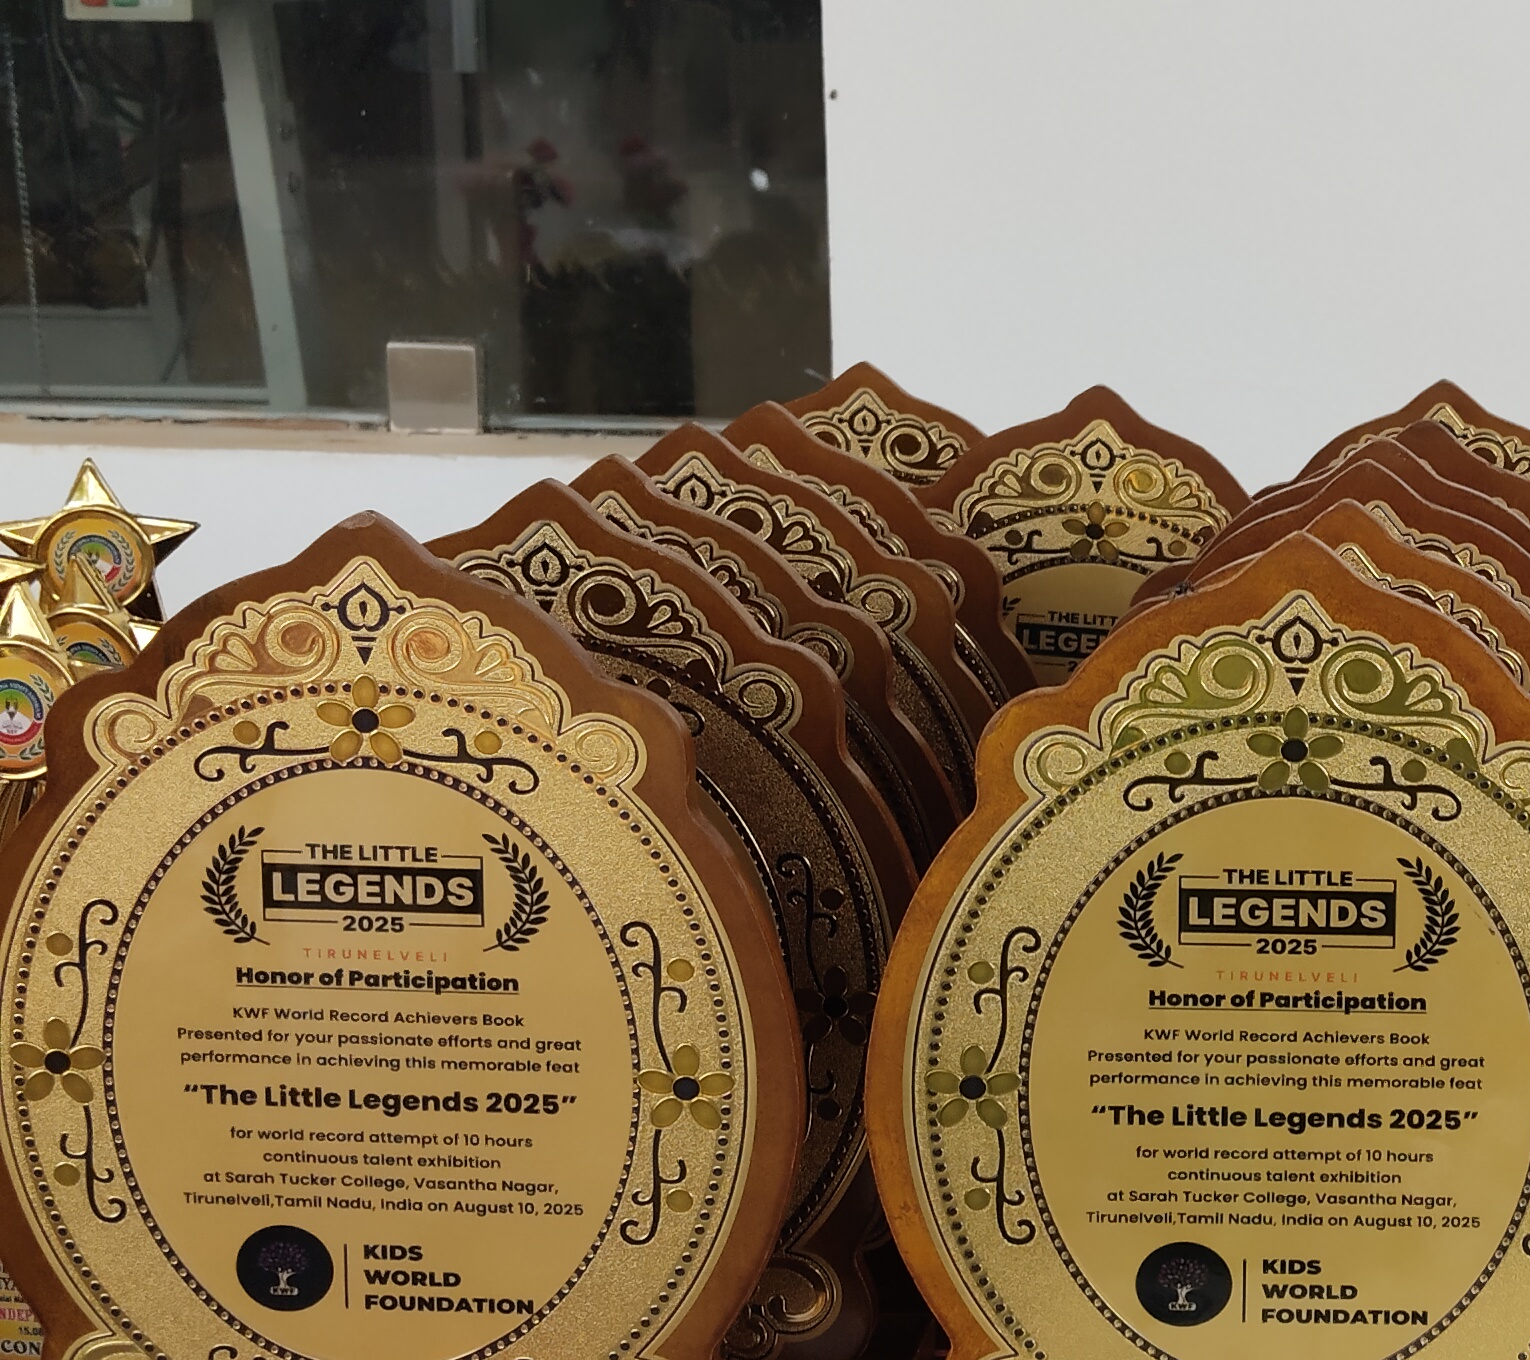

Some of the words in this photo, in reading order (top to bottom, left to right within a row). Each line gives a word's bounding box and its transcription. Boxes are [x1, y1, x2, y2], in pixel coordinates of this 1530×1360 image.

[303, 841, 353, 861] THE
[357, 843, 438, 863] LITTLE
[1221, 867, 1270, 886] THE
[1273, 868, 1353, 887] LITTLE
[271, 870, 474, 907] LEGENDS
[1187, 895, 1387, 929] LEGENDS
[341, 914, 405, 934] 2025
[1255, 936, 1318, 956] 2025
[235, 966, 314, 987] Honor
[318, 968, 345, 987] of
[348, 969, 520, 996] Participation
[1214, 969, 1358, 984] TIRUNELVELI
[1148, 988, 1227, 1008] Honor
[1230, 990, 1257, 1009] of
[1259, 990, 1428, 1015] Participation
[1142, 1027, 1181, 1041] KWF
[1183, 1028, 1235, 1042] World
[1238, 1029, 1298, 1043] Record
[1301, 1029, 1385, 1045] Achievers
[1388, 1031, 1430, 1046] Book
[1086, 1048, 1173, 1063] Presented
[1175, 1048, 1200, 1064] for
[1202, 1052, 1243, 1068] your
[1245, 1050, 1341, 1068] passionate
[1343, 1051, 1398, 1067] efforts
[1401, 1053, 1436, 1068] and
[1438, 1055, 1485, 1072] great
[1088, 1070, 1201, 1088] performance
[1203, 1071, 1220, 1086] in
[1223, 1072, 1308, 1091] achieving
[1310, 1073, 1342, 1088] this
[1346, 1075, 1446, 1089] memorable
[1448, 1075, 1483, 1090] feat
[182, 1082, 258, 1106] “The
[263, 1082, 342, 1109] Little
[347, 1087, 479, 1116] Legends
[484, 1091, 577, 1115] 2025”
[1090, 1103, 1165, 1126] “The
[1171, 1102, 1248, 1127] Little
[1253, 1106, 1383, 1134] Legends
[1388, 1107, 1479, 1131] 2025”
[1105, 1188, 1125, 1202] at
[1127, 1188, 1178, 1203] Sarah
[1181, 1189, 1240, 1204] Tucker
[1242, 1190, 1311, 1208] College,
[1314, 1191, 1397, 1206] Vasantha
[1400, 1193, 1457, 1210] Nagar,
[1084, 1209, 1224, 1226] Tirunelveli,Tamil
[1227, 1211, 1277, 1227] Nadu,
[1280, 1212, 1324, 1226] India
[1326, 1215, 1349, 1227] on
[1352, 1213, 1413, 1231] August
[1415, 1214, 1437, 1230] 10,
[1440, 1214, 1481, 1229] 2025
[362, 1243, 424, 1262] KIDS
[1261, 1257, 1322, 1275] KIDS
[362, 1268, 462, 1288] WORLD
[1260, 1282, 1359, 1300] WORLD
[363, 1293, 537, 1318] FOUNDATION
[1260, 1307, 1429, 1326] FOUNDATION
